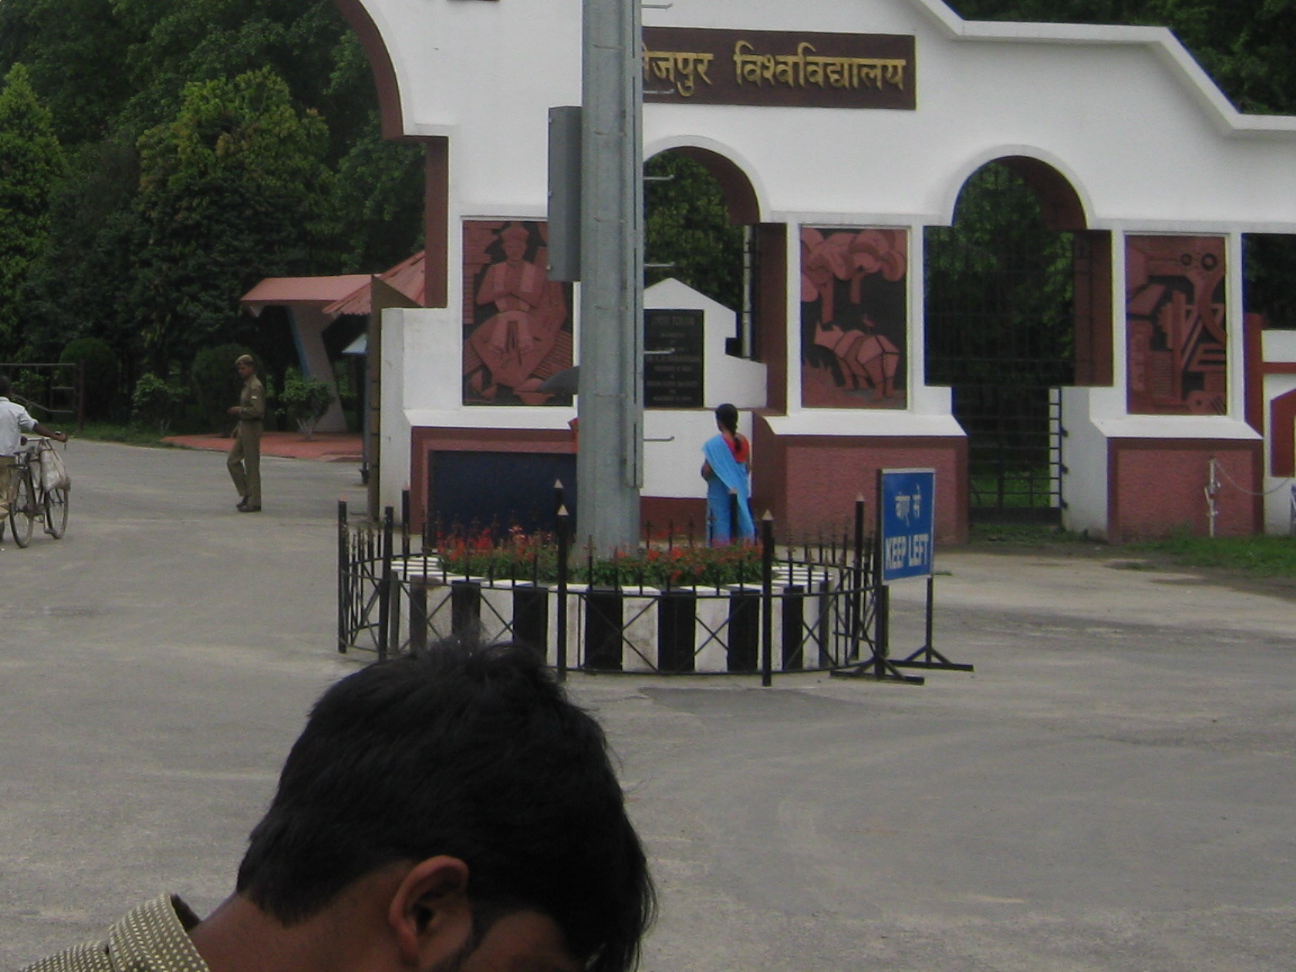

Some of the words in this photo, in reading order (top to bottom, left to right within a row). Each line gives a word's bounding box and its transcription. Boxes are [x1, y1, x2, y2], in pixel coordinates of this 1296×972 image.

[733, 40, 907, 91] विश्वविद्यालय
[885, 535, 907, 571] KEEP
[908, 533, 929, 567] LEFT
